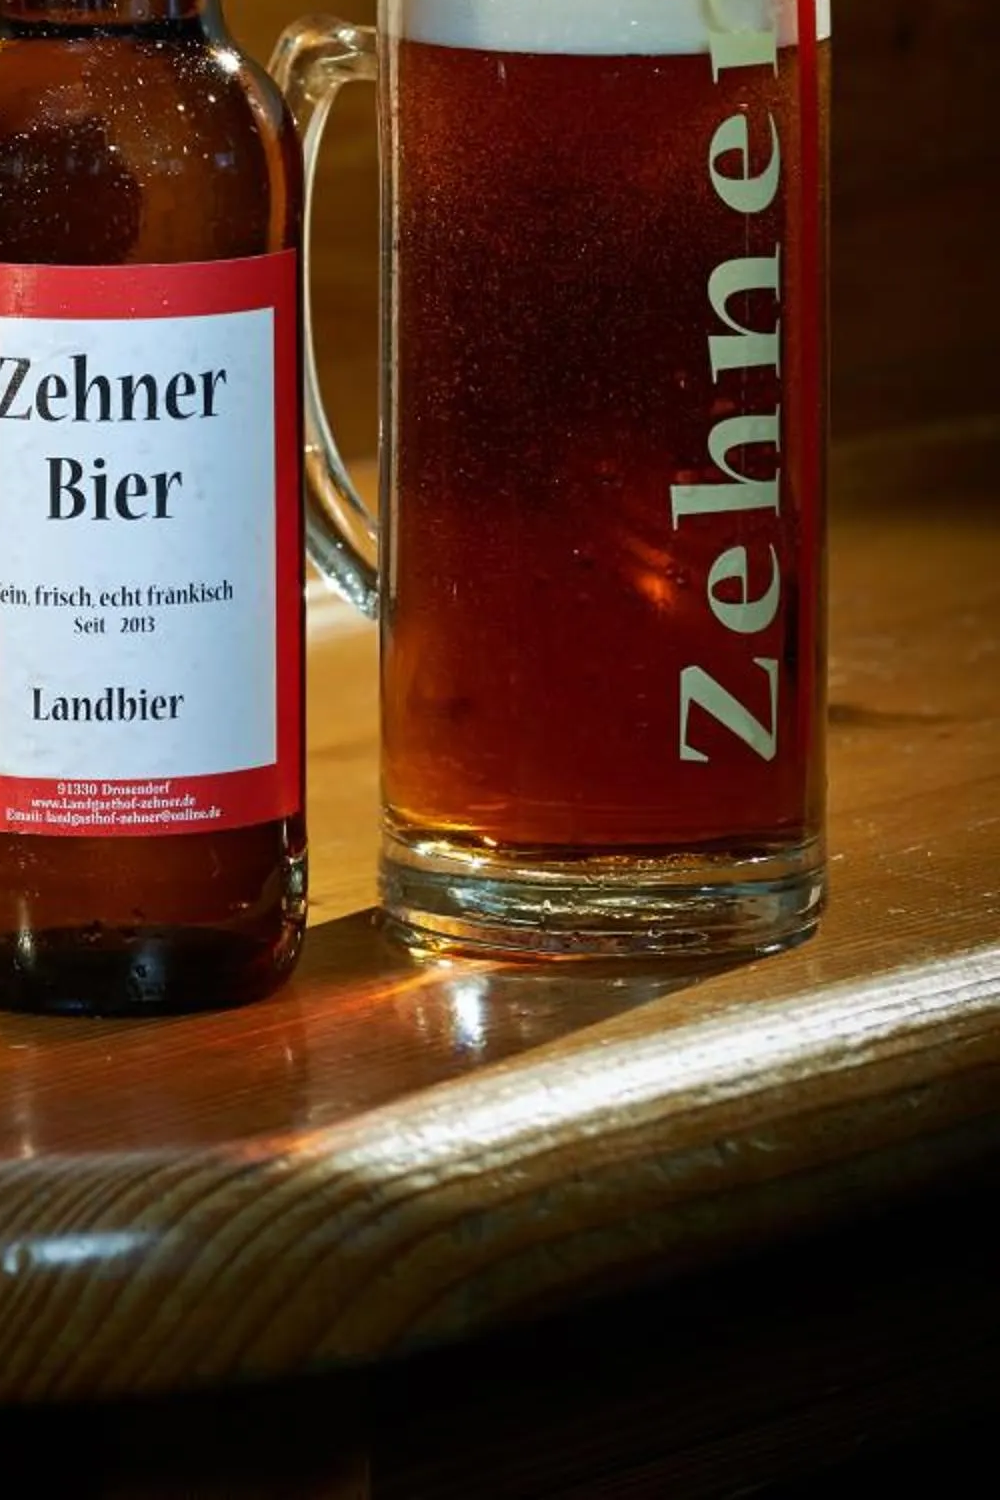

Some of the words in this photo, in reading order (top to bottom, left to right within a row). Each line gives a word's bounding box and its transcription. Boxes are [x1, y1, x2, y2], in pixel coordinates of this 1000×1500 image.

[45, 456, 183, 521] Bier
[99, 585, 143, 607] echt
[73, 616, 105, 633] Seit
[120, 616, 155, 633] 2013
[31, 687, 185, 722] Landbier
[57, 782, 97, 796] 91330
